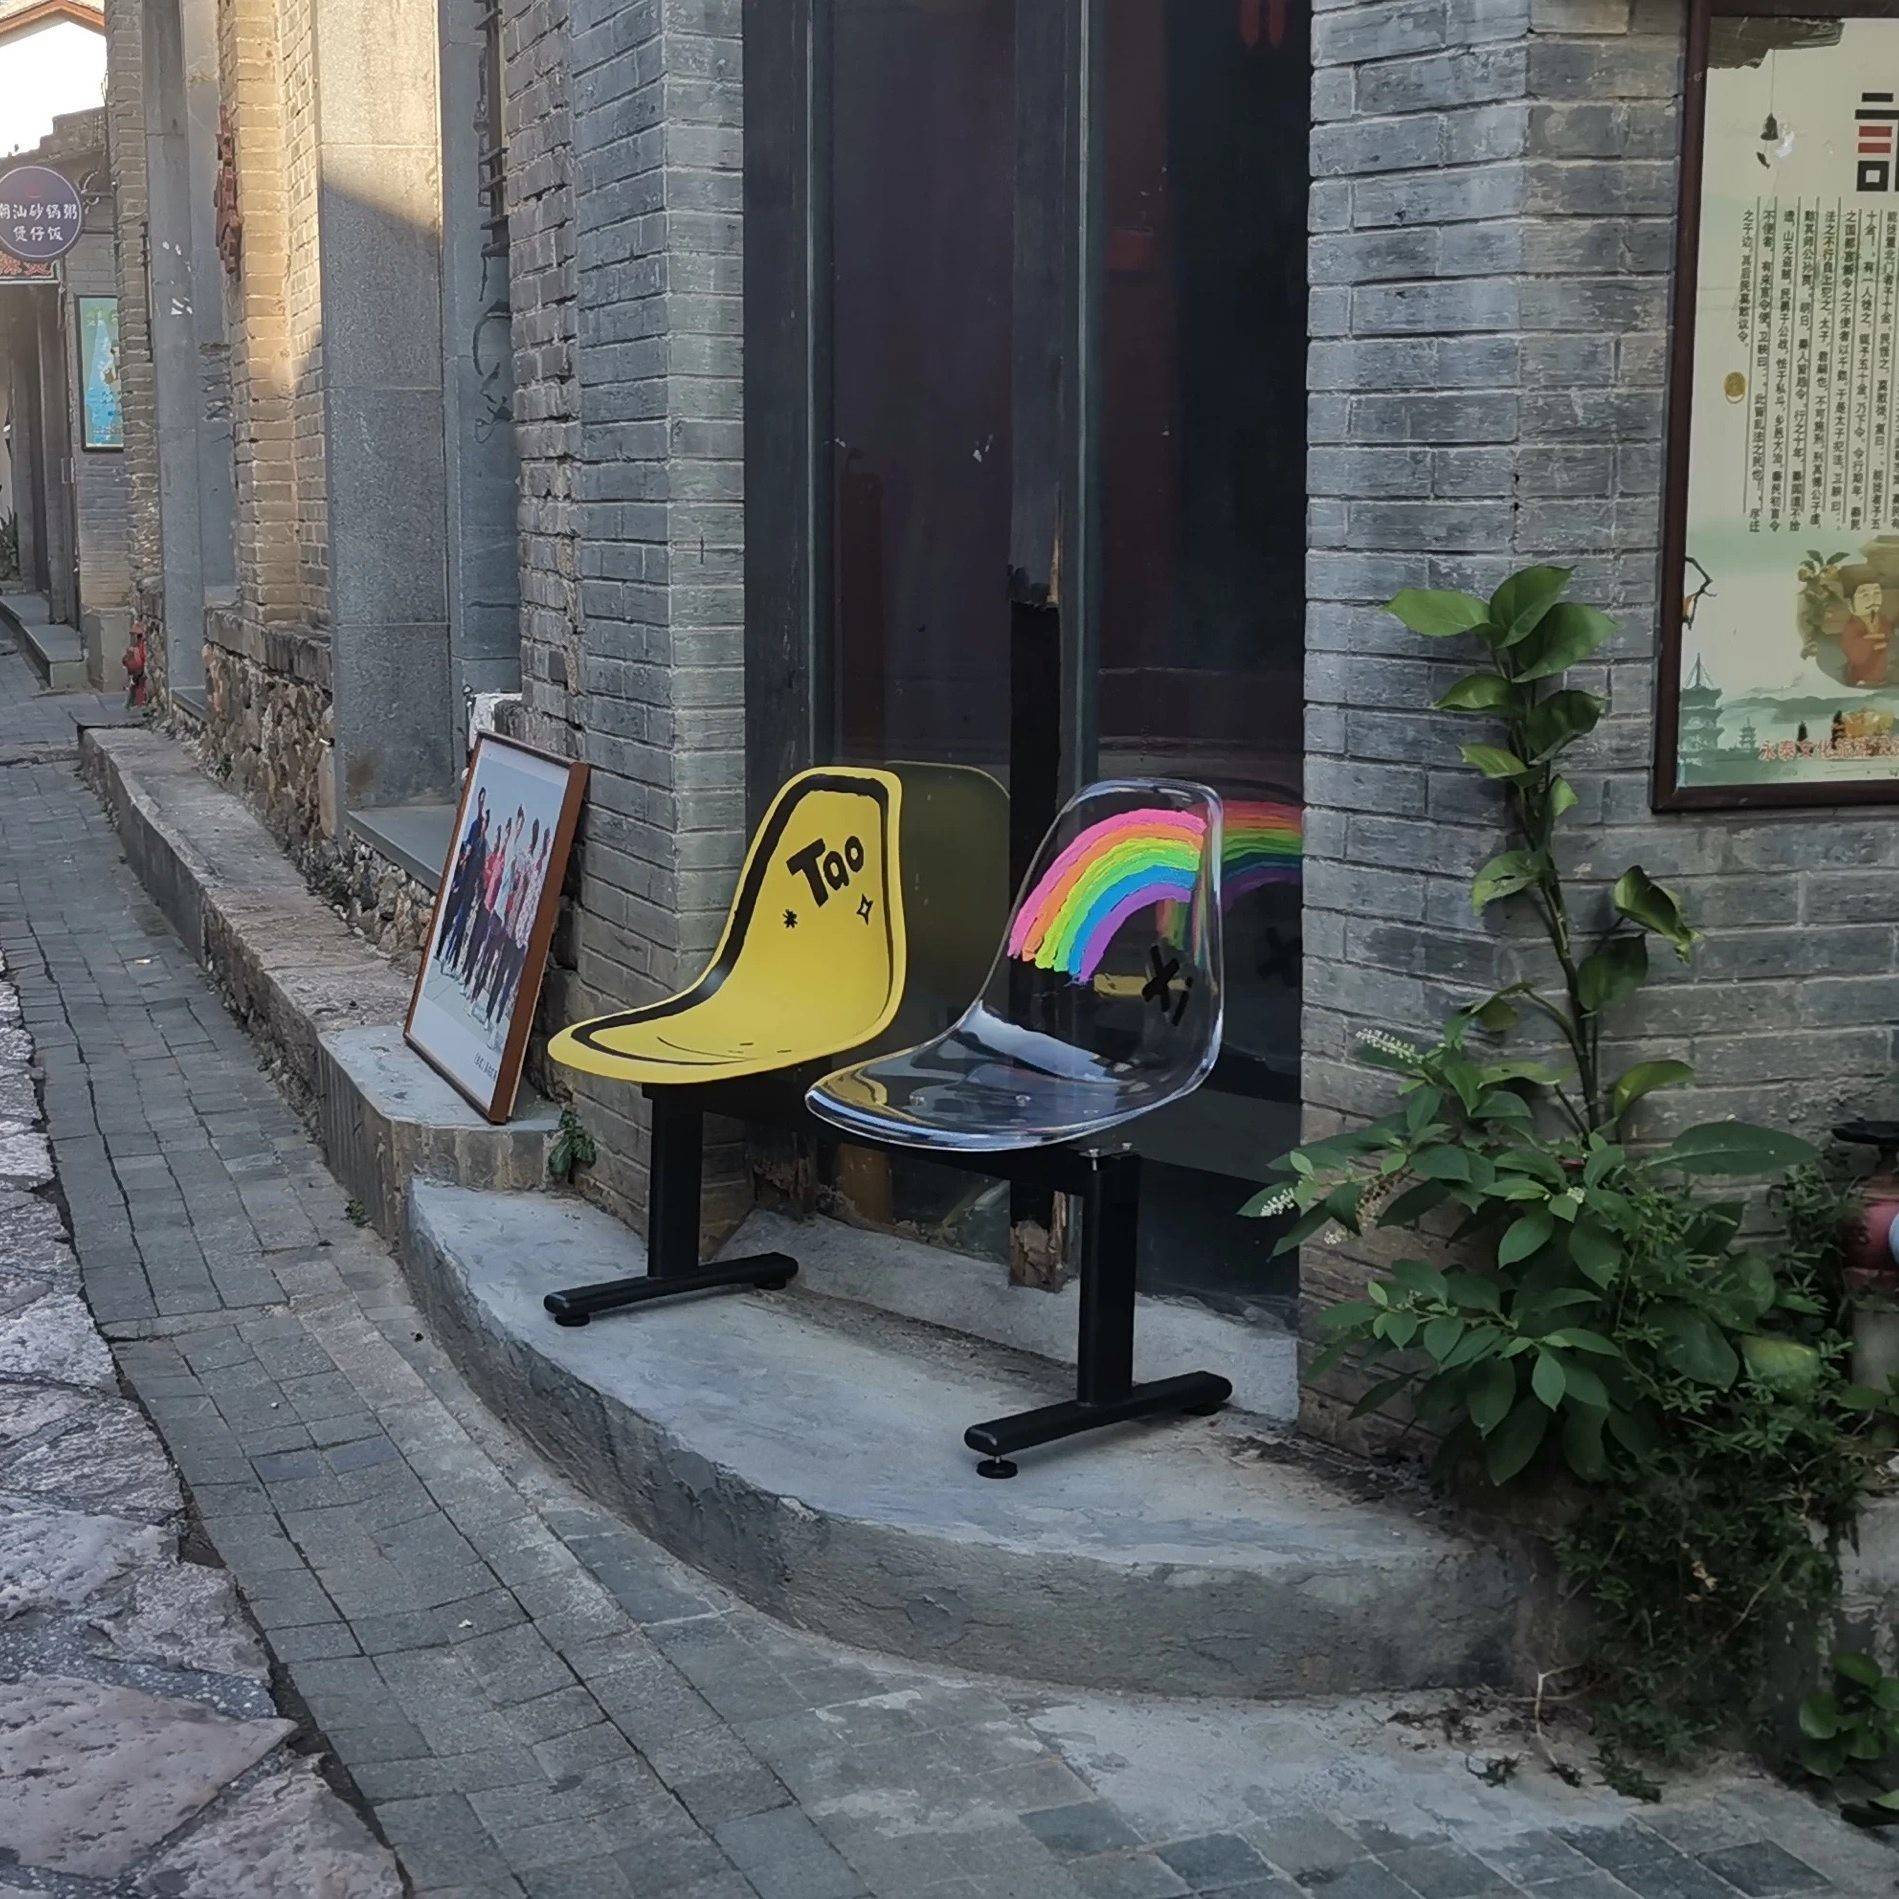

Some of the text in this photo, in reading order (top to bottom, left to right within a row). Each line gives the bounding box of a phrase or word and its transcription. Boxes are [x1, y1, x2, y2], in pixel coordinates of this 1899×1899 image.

[13, 225, 63, 241] 煲仔饭
[786, 836, 864, 908] Tao
